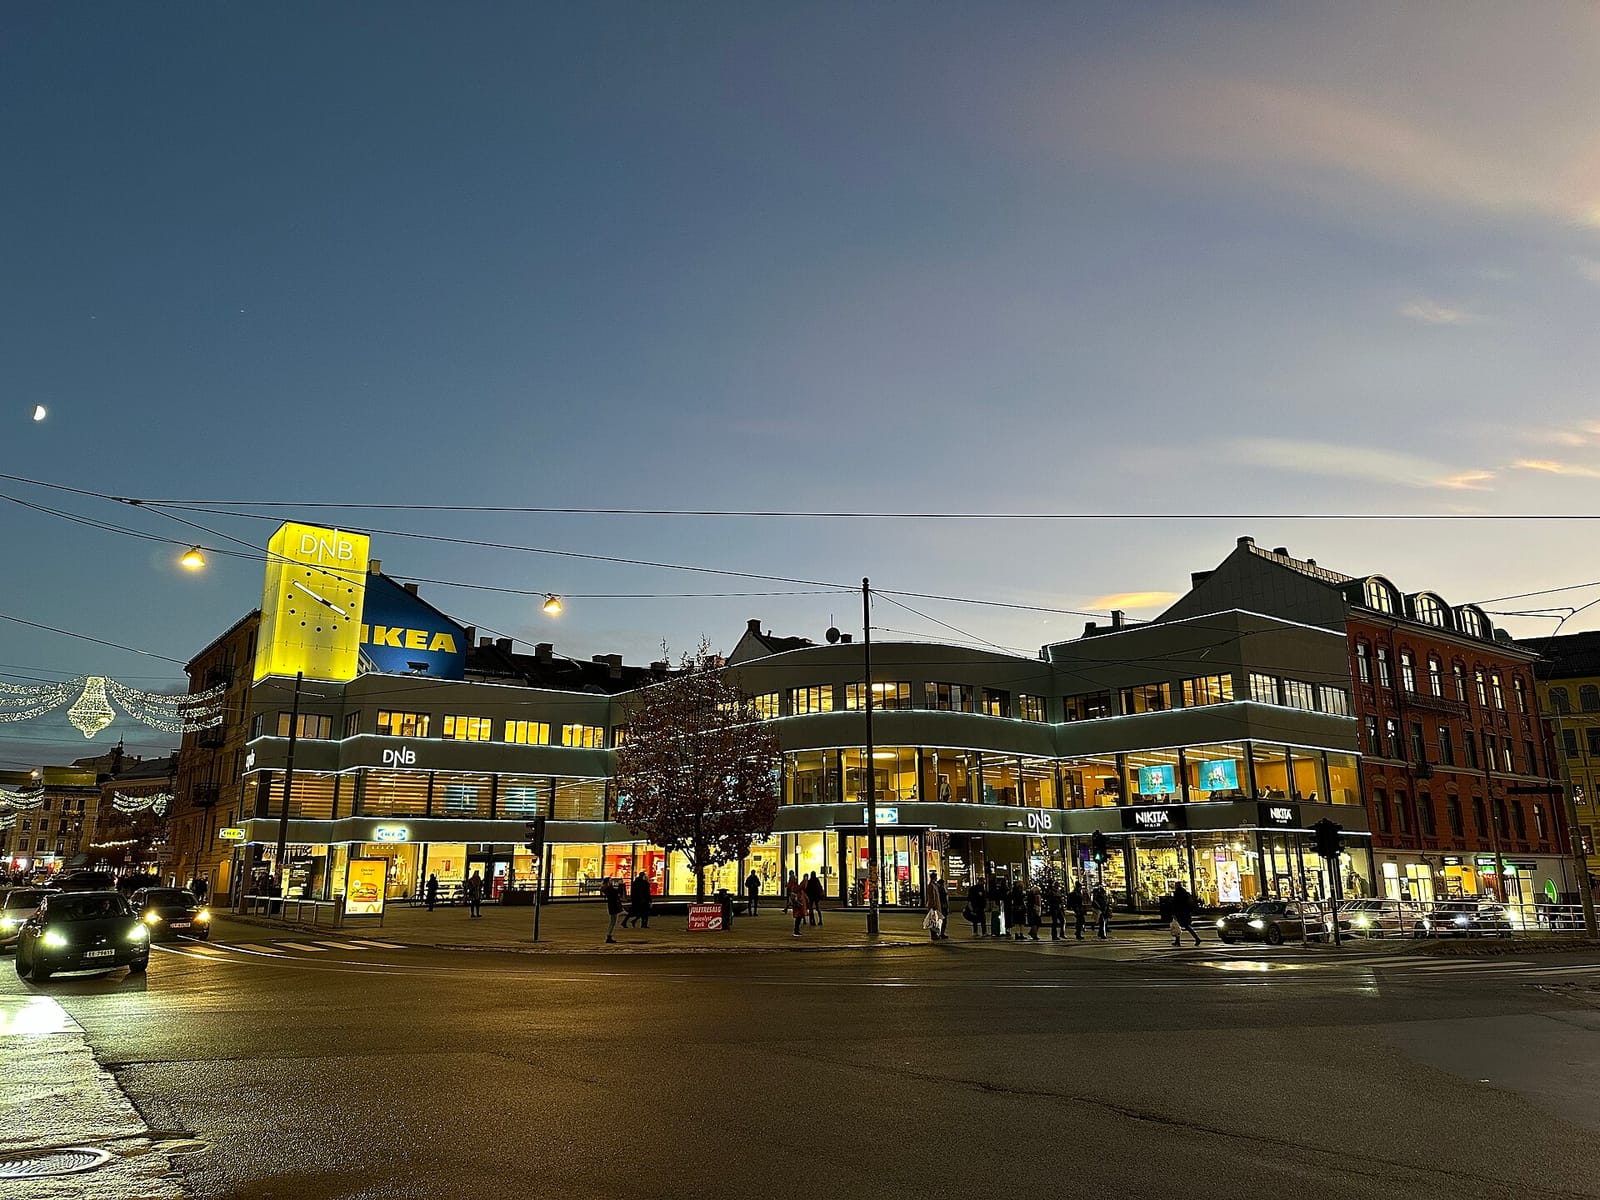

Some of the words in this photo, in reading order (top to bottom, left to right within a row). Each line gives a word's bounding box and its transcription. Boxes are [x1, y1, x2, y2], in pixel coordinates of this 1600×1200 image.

[300, 528, 353, 563] DNB
[360, 624, 458, 654] IKEA
[382, 745, 416, 768] DNB
[1027, 809, 1052, 834] DNB
[1135, 810, 1169, 824] NIKITA
